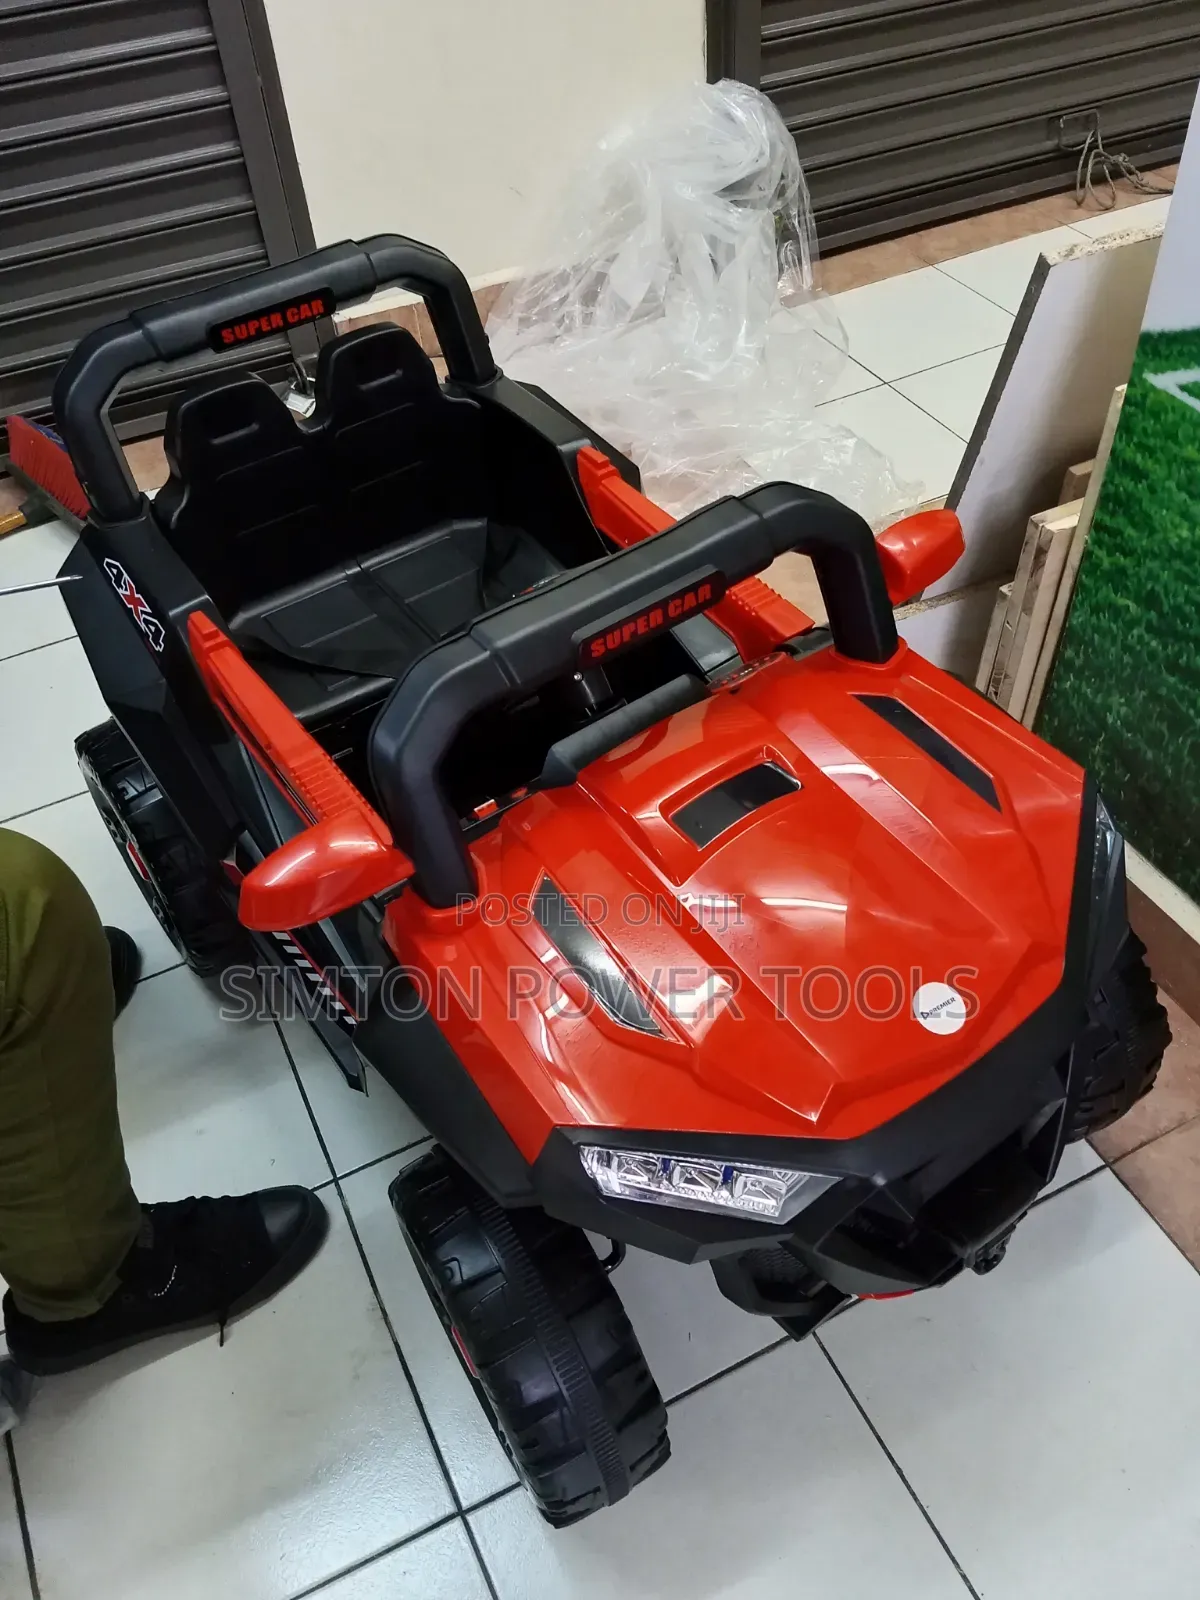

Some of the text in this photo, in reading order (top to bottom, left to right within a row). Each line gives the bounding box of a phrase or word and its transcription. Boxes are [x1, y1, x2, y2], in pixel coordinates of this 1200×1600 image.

[221, 299, 325, 345] SUPER CAR
[103, 557, 165, 652] 4X4
[590, 583, 712, 657] SUPER CAR
[929, 997, 956, 1015] PREMIER
